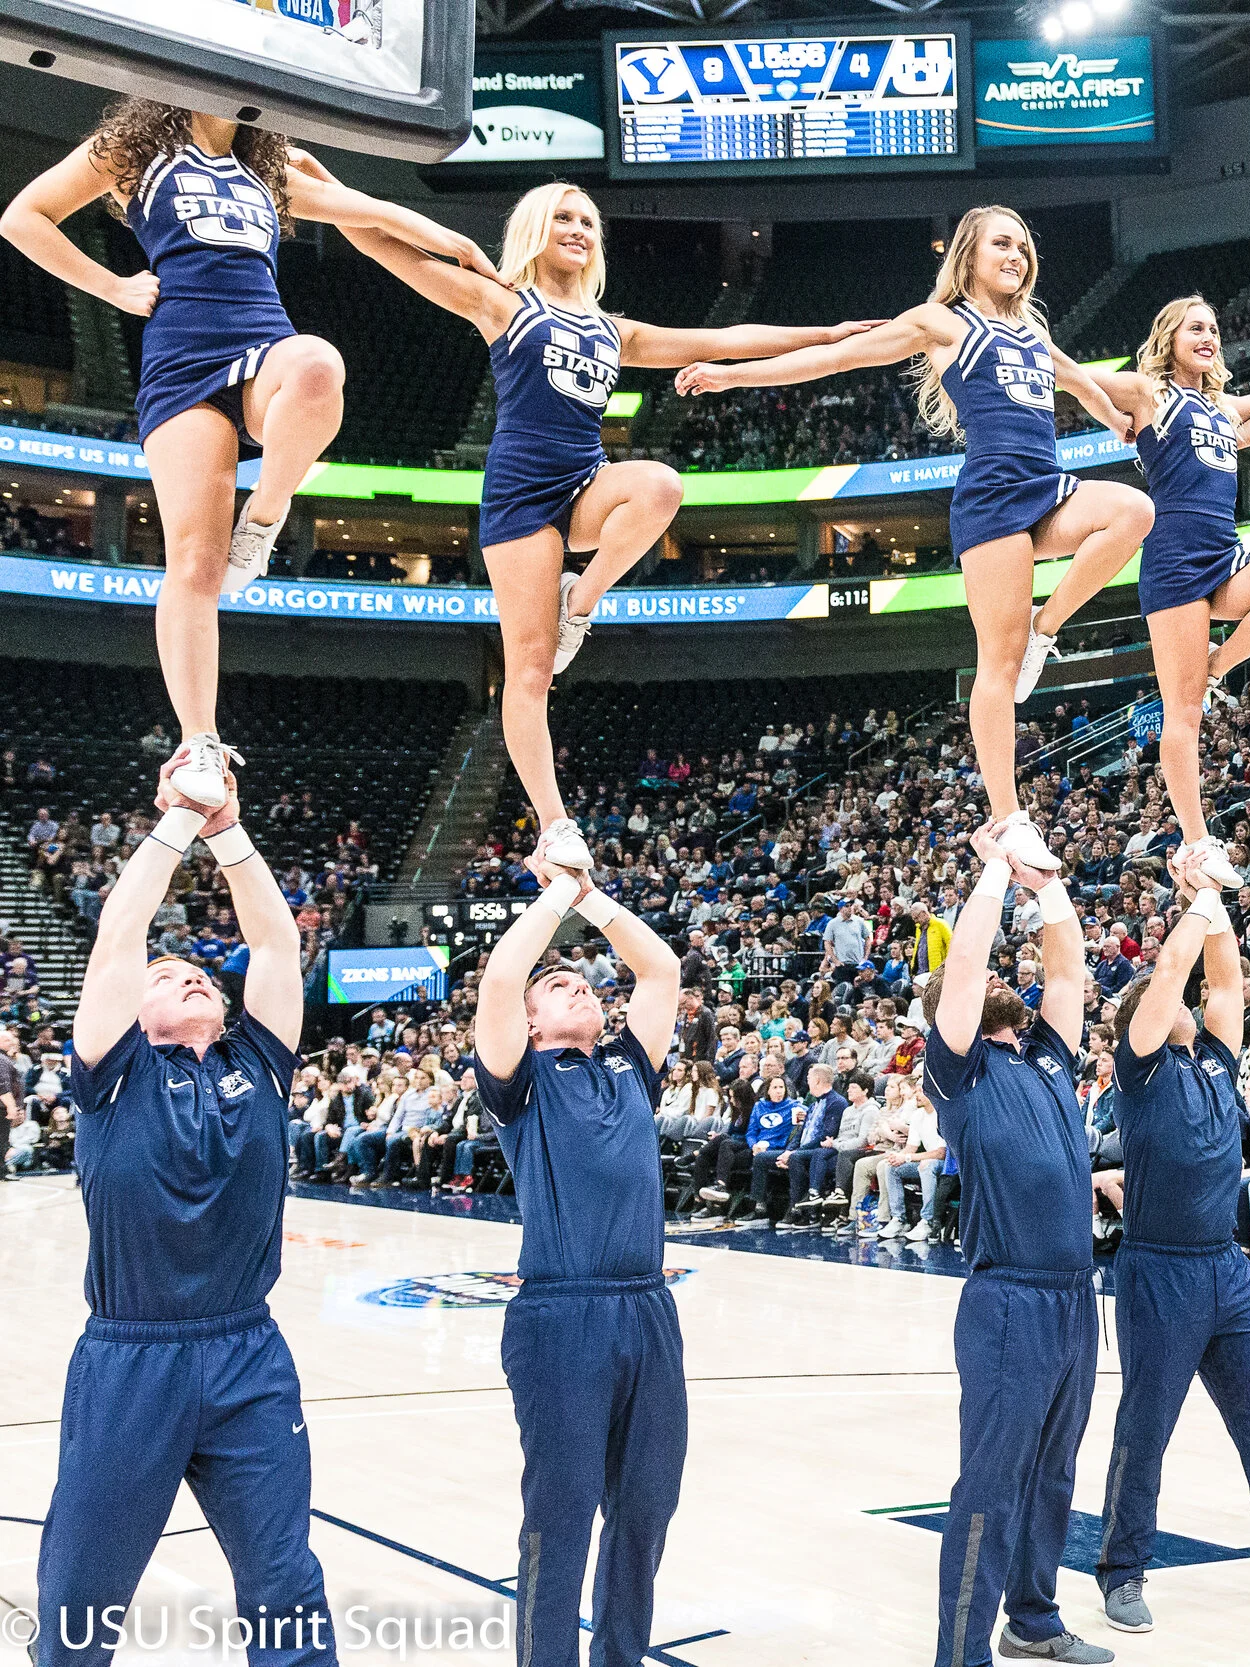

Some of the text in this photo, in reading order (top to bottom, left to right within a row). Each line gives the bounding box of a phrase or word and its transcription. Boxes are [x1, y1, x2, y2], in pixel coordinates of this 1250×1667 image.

[286, 0, 324, 22] NBA
[850, 53, 870, 78] 4
[985, 77, 1144, 102] AMERICA FIRST
[1021, 98, 1109, 111] CREDIT UNION
[501, 126, 554, 145] Divvy
[173, 194, 275, 236] STATE
[543, 344, 619, 392] STATE
[19, 439, 76, 460] KEEPS
[79, 447, 104, 463] US
[108, 452, 129, 467] IN
[889, 471, 912, 484] WE
[1061, 444, 1093, 461] WHO
[50, 570, 95, 593] WE
[229, 586, 393, 612] FORGOTTEN
[402, 594, 465, 616] WHO
[341, 968, 389, 983] ZIONS
